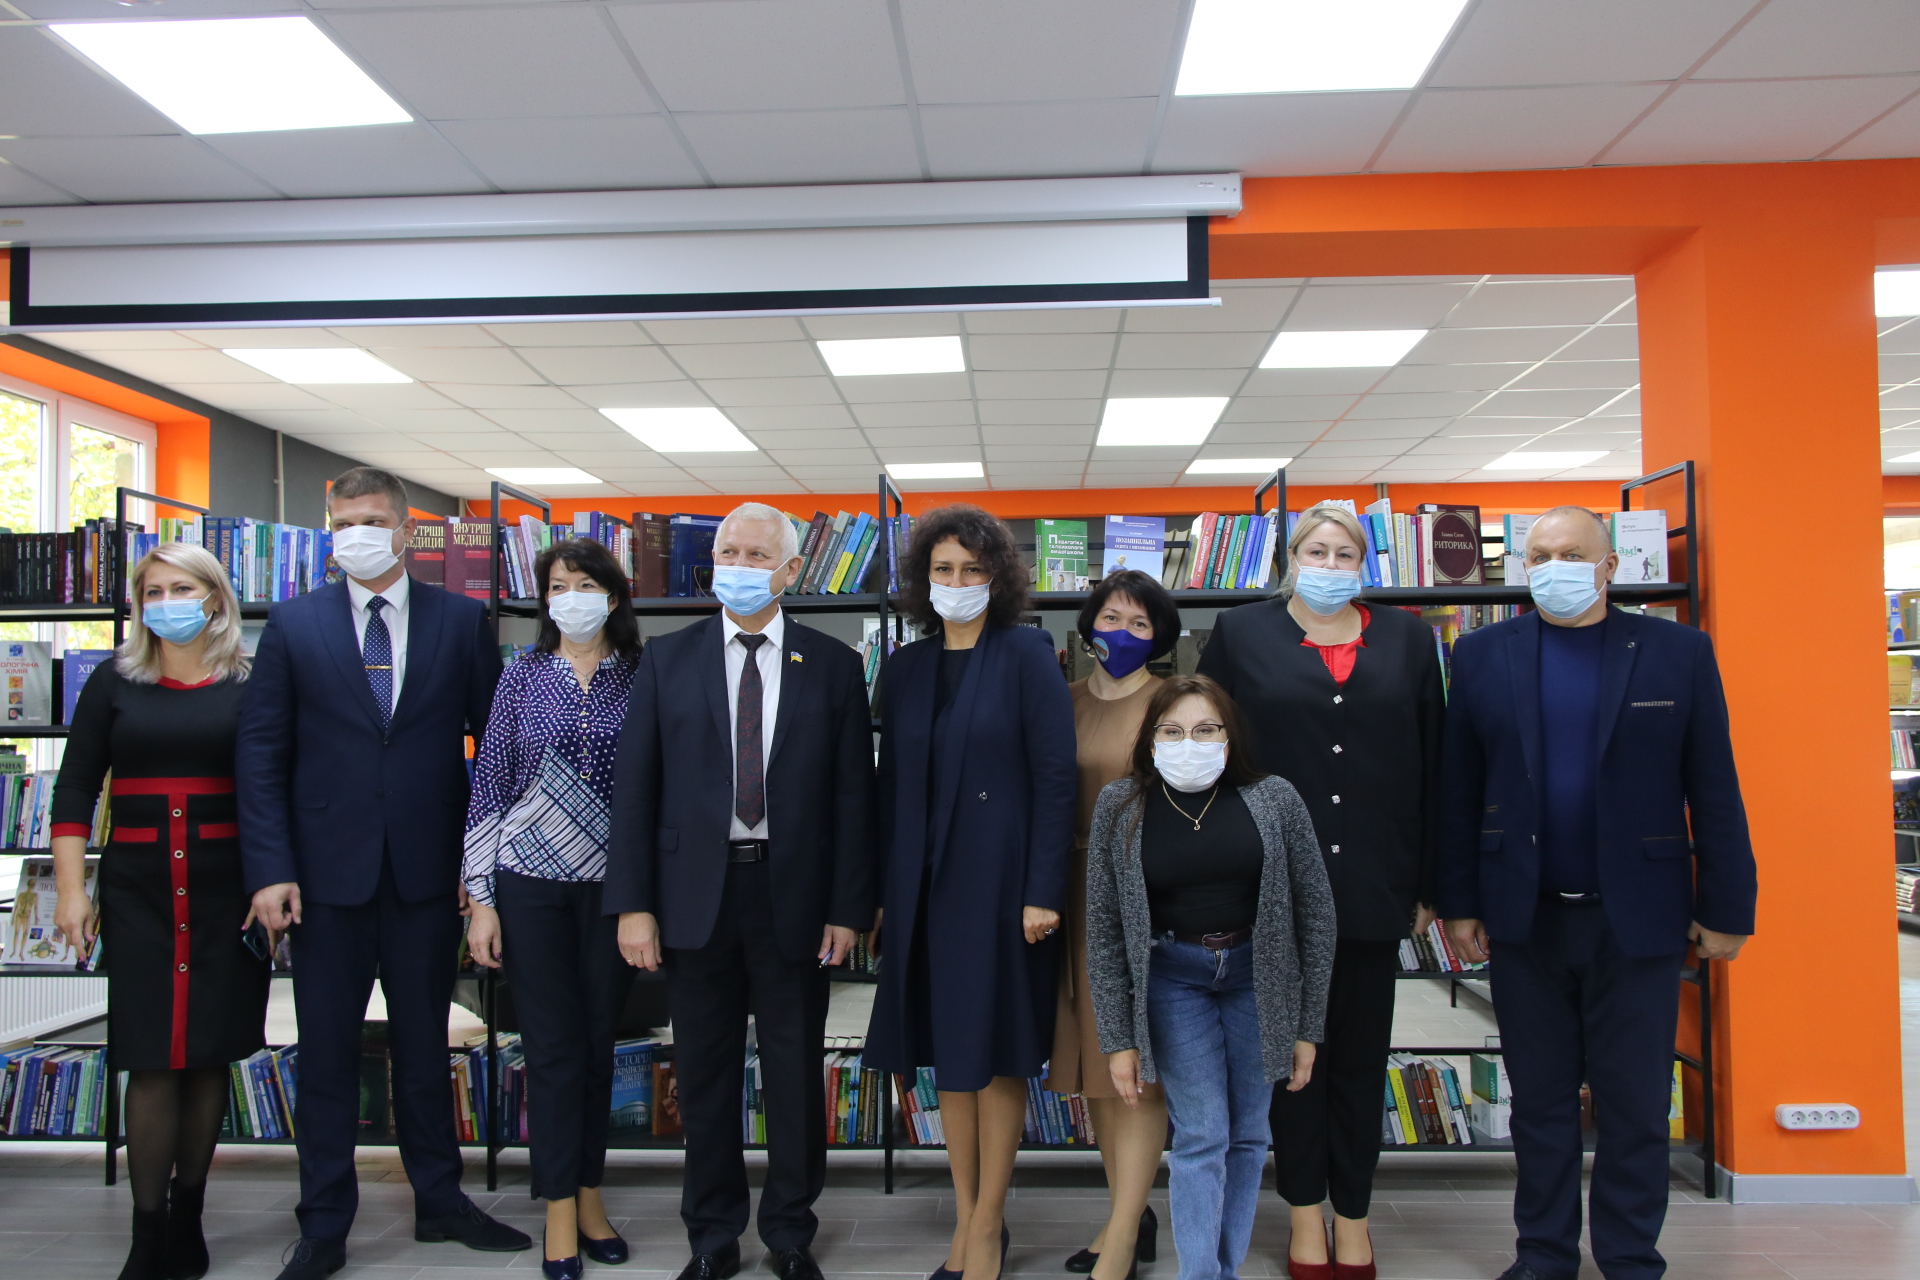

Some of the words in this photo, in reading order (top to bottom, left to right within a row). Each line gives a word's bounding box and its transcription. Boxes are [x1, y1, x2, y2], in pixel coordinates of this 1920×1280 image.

[453, 523, 491, 534] ВНУТРІШ
[406, 537, 445, 550] ЕДИЦИН
[453, 534, 491, 548] МЕДИЦИ
[1048, 533, 1083, 545] ПЕДАГОГІКА
[1434, 541, 1474, 550] РИТОРИКА
[1618, 546, 1637, 557] ам!
[98, 563, 106, 597] ЗАГАЛЬНА
[1067, 638, 1075, 671] СПОРТ
[1170, 647, 1178, 669] СПО
[38, 883, 57, 892] ЛЮД
[50, 1076, 61, 1128] ІНФОРМАТИКА
